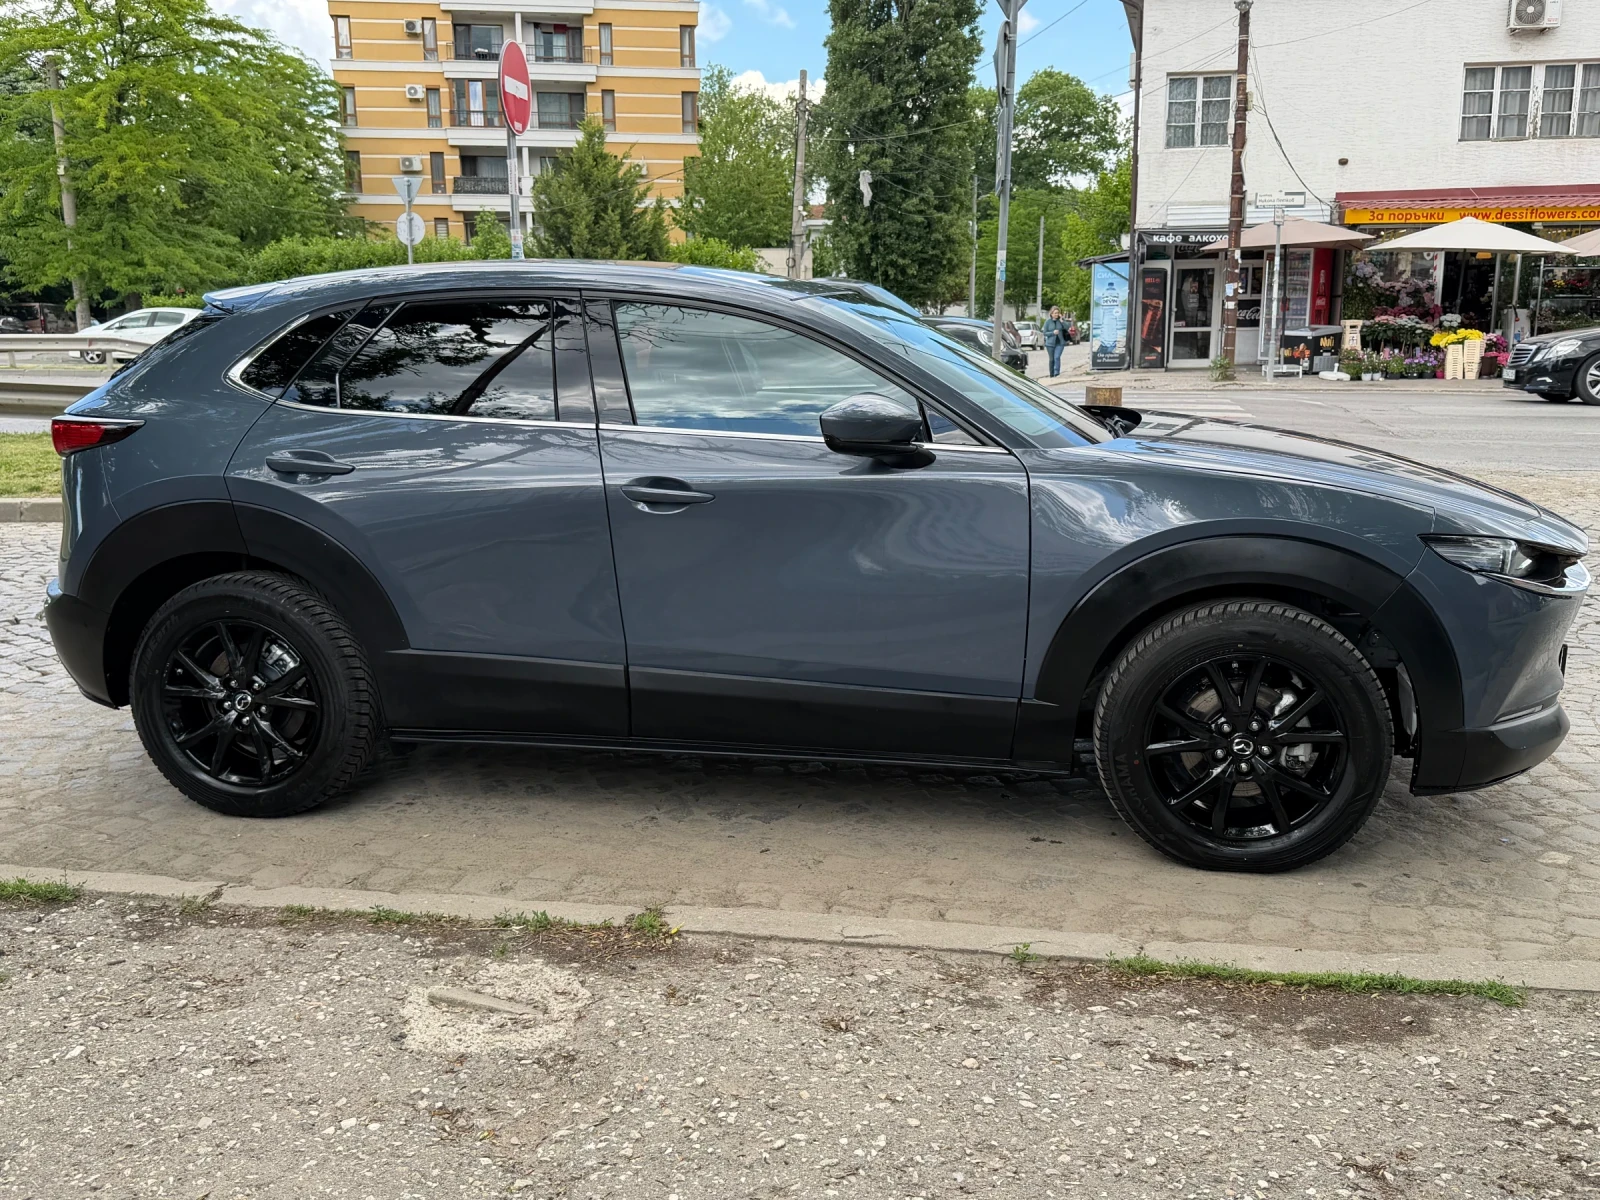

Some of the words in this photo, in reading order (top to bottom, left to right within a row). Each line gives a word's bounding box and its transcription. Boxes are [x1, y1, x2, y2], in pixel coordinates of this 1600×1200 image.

[1368, 210, 1384, 221] За
[1388, 211, 1445, 223] поръчки
[1153, 233, 1182, 243] кафе
